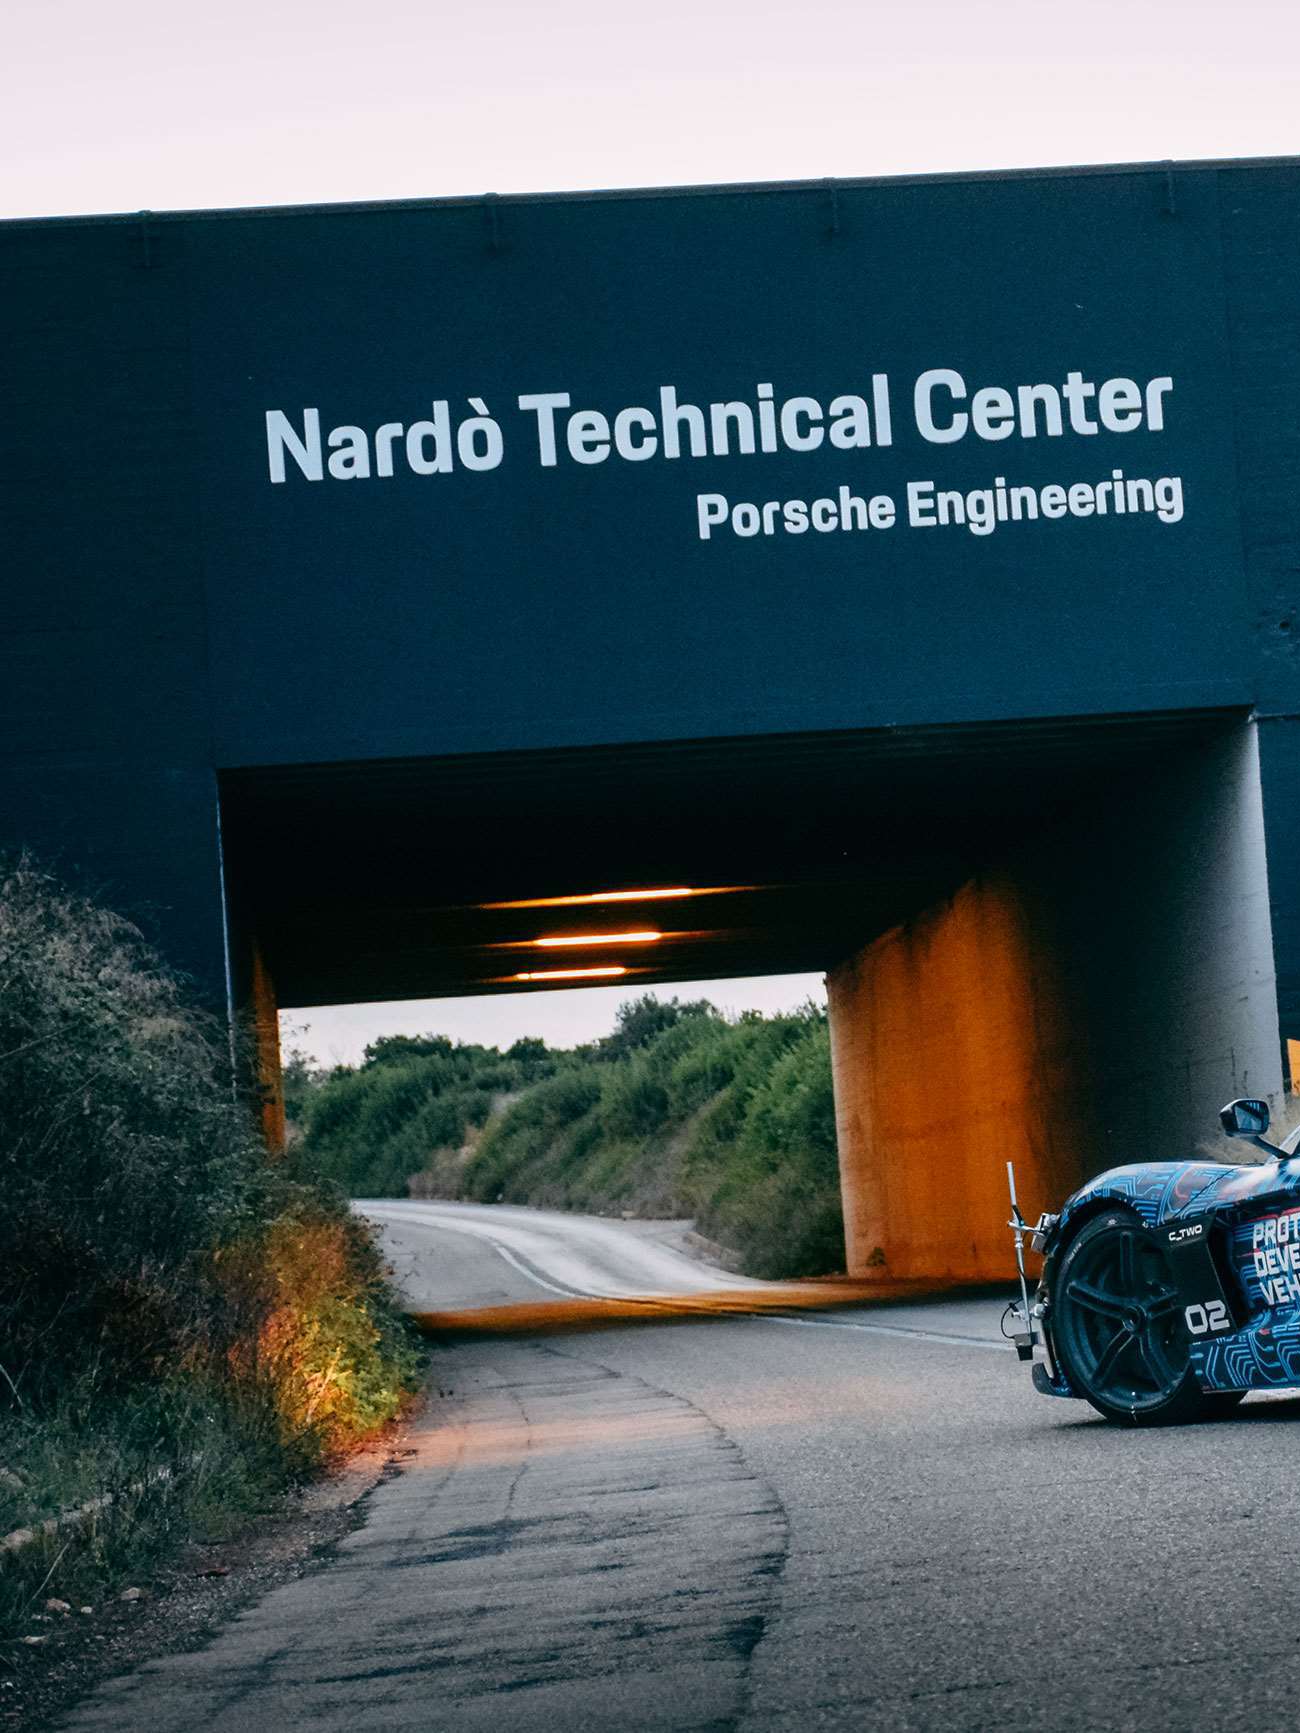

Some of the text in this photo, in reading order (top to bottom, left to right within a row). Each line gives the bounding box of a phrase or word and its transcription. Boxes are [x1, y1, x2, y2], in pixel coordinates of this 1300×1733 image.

[265, 368, 1173, 483] Nardò Technical Center
[696, 469, 1184, 540] Porsche Engineering
[1168, 1224, 1203, 1242] C_TWO
[1184, 1299, 1231, 1335] 02
